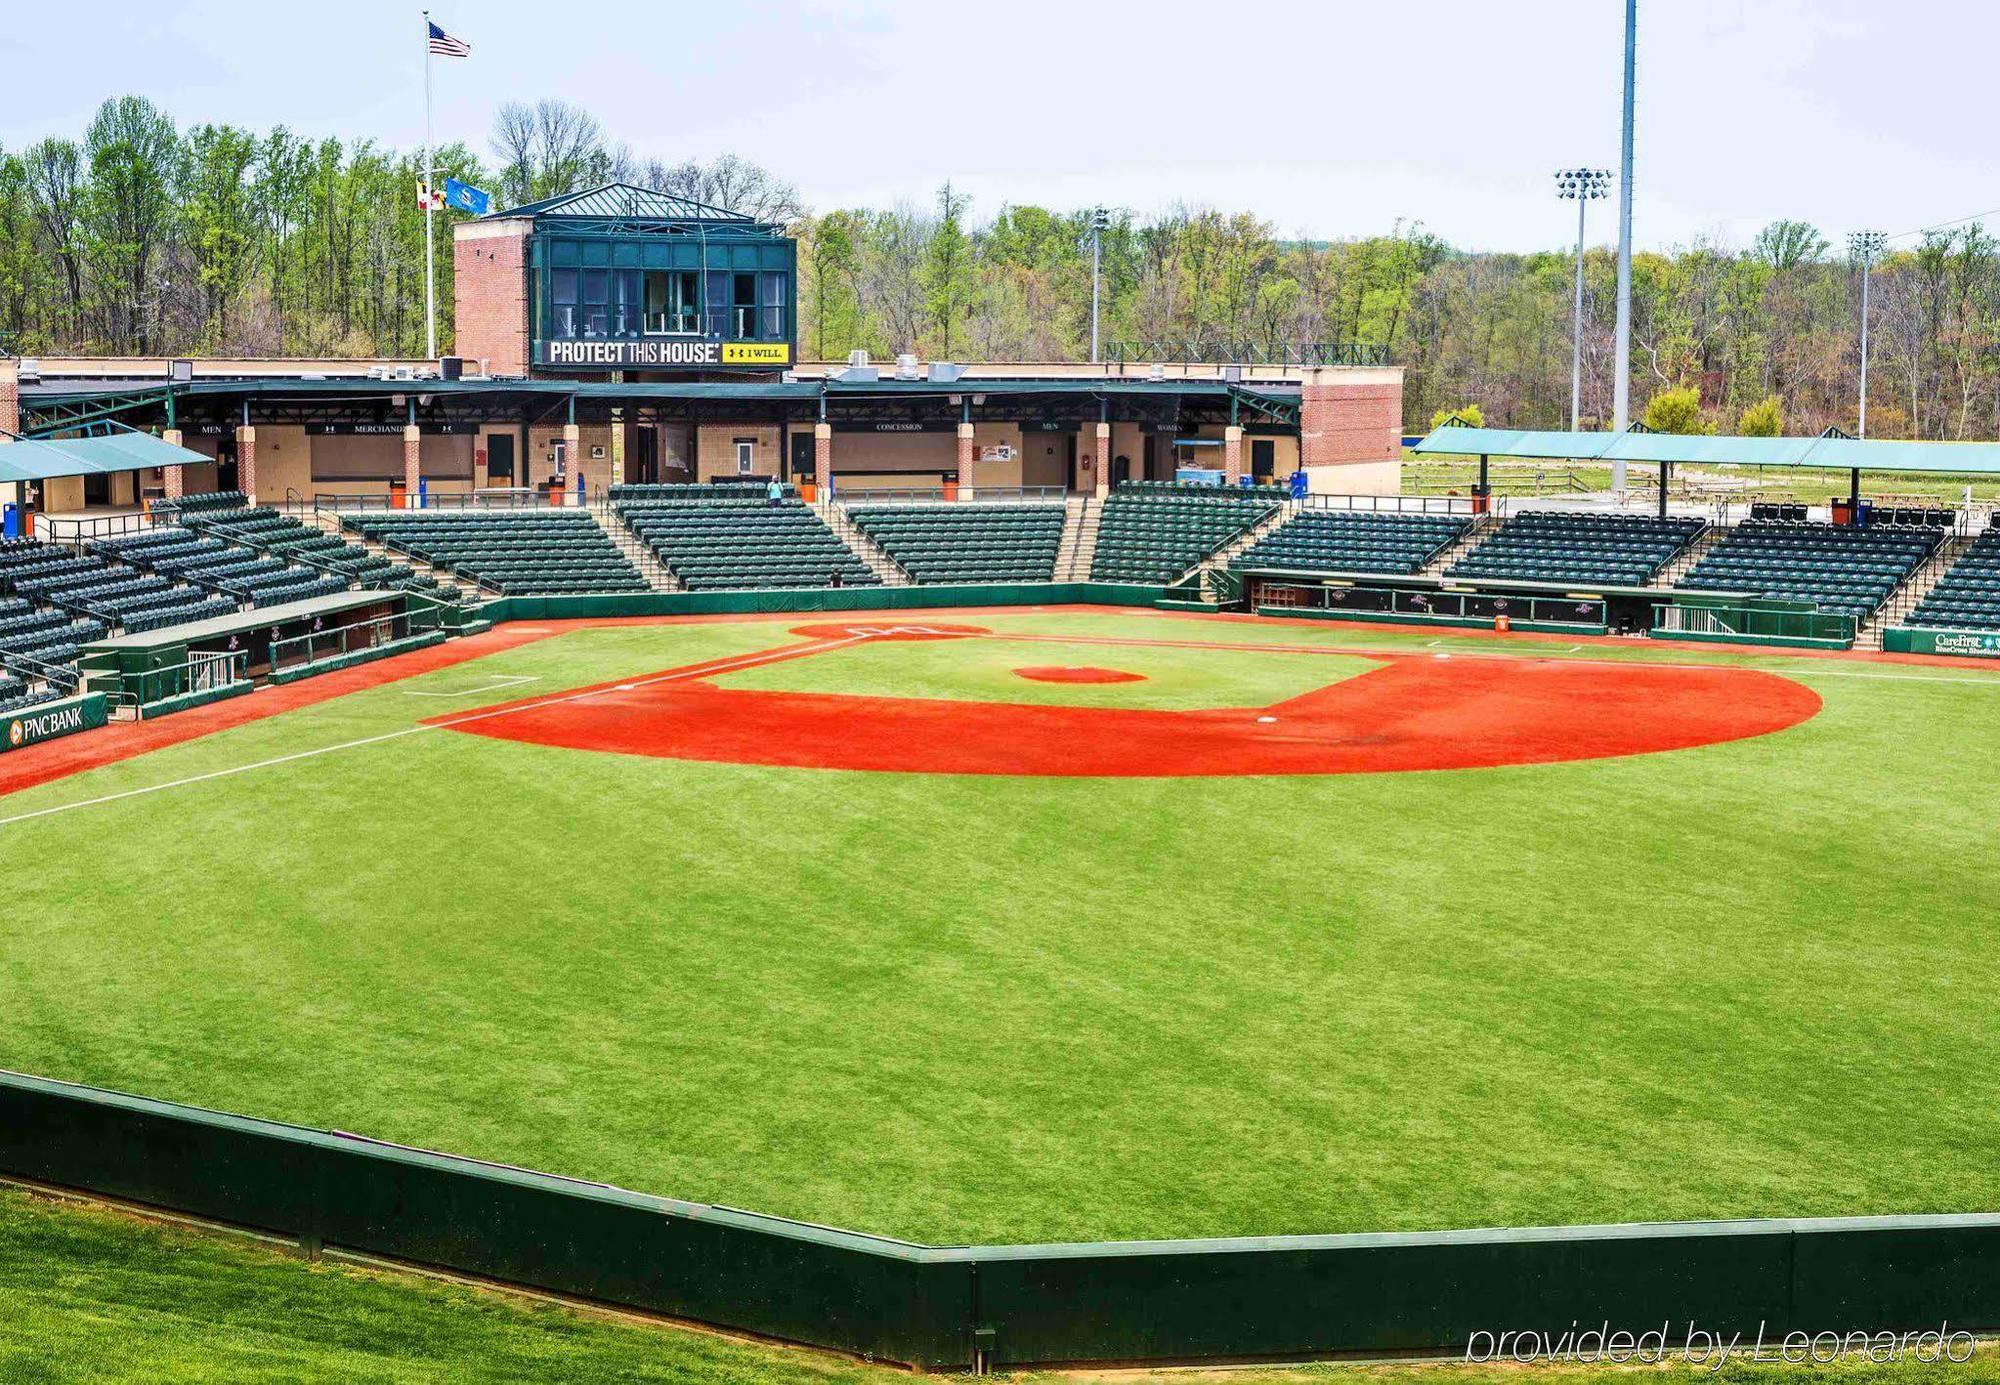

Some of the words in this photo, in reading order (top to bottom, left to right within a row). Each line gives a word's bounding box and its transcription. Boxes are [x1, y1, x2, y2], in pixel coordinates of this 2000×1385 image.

[550, 341, 625, 363] PROTECT
[628, 342, 657, 363] THIS
[876, 423, 922, 431] CONCESSION
[1935, 634, 1982, 648] CareFirst
